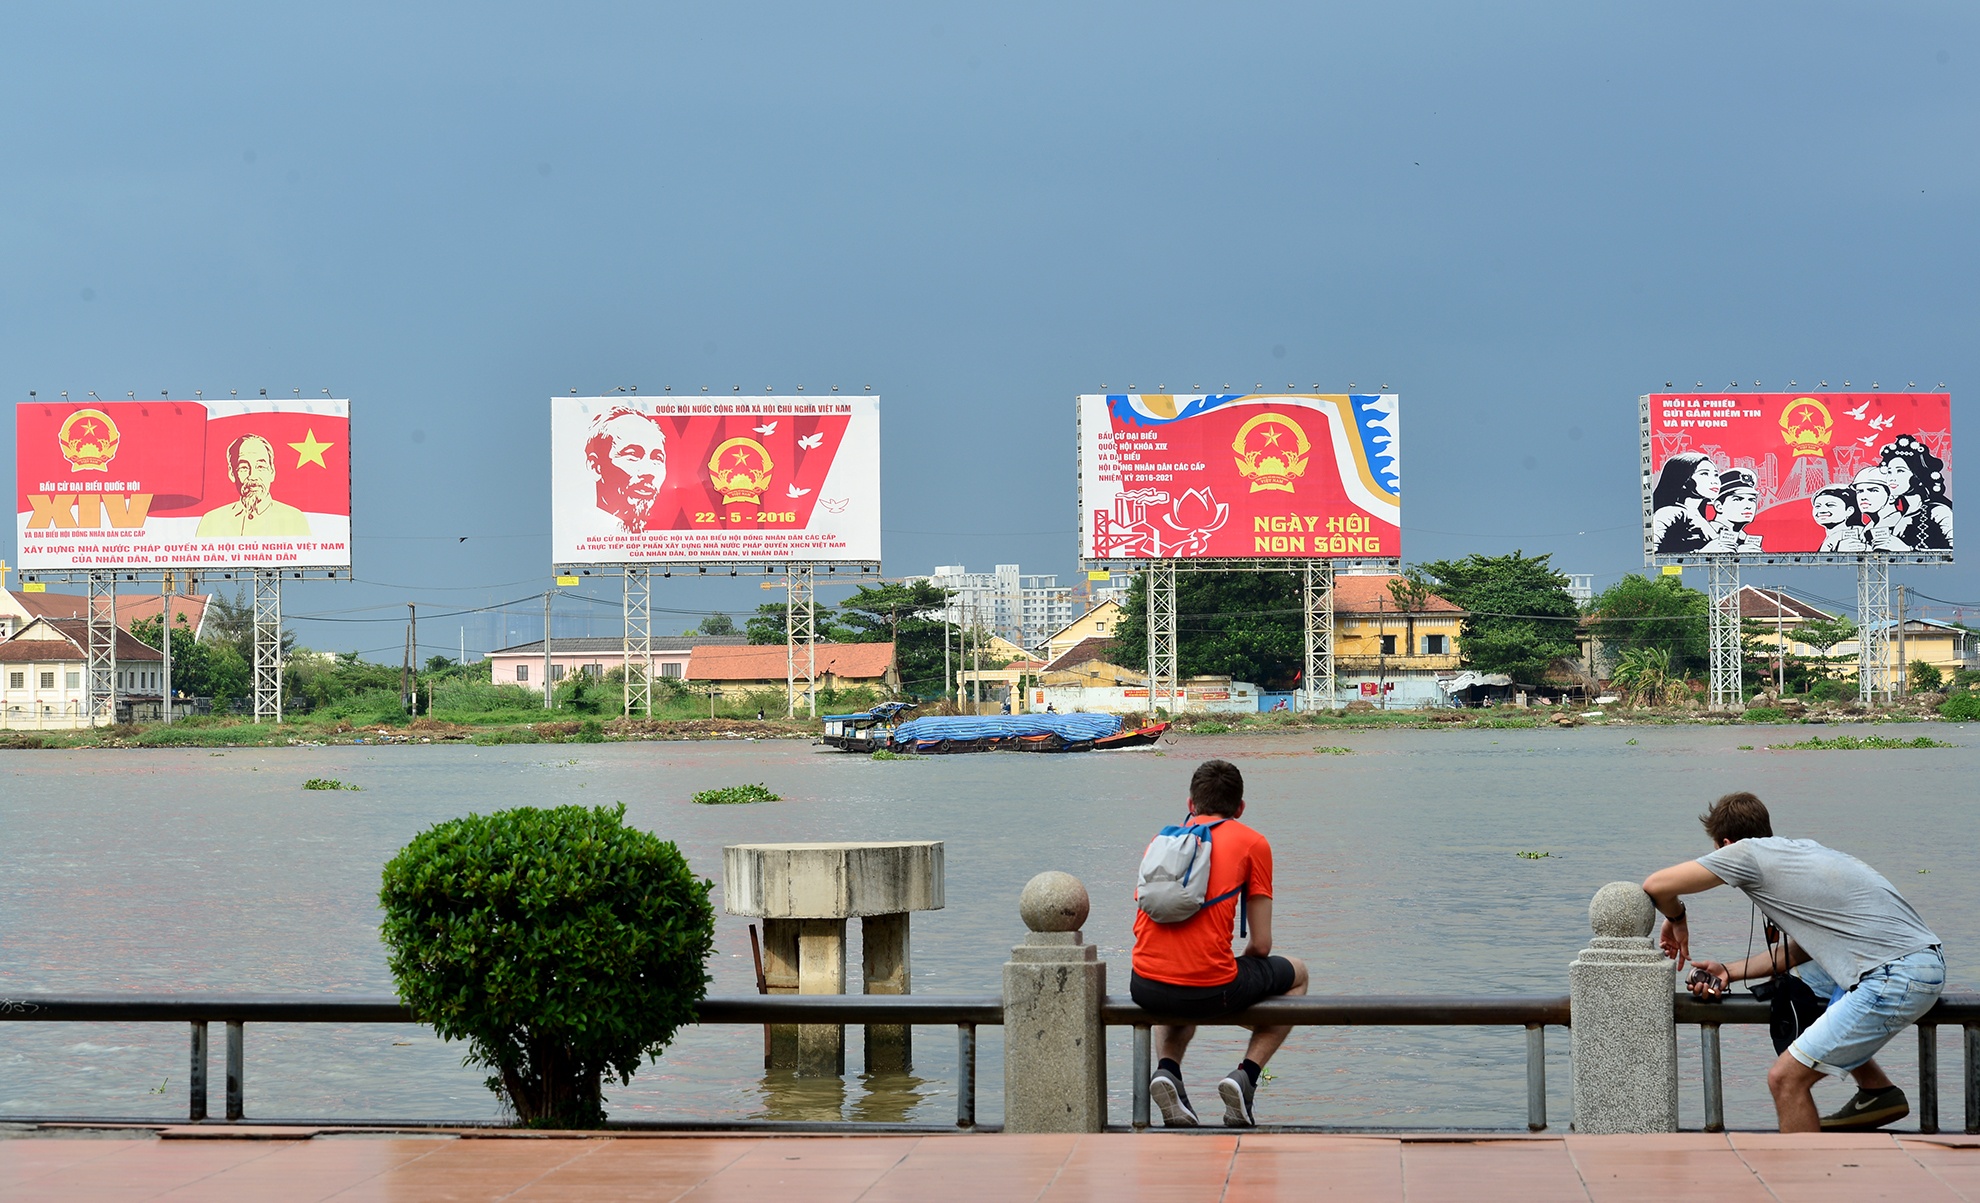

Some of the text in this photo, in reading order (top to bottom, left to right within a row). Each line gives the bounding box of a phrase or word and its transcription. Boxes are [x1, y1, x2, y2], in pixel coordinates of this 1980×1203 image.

[835, 404, 851, 413] NAM
[1135, 474, 1173, 482] 2016-2021
[26, 494, 154, 529] XIV
[695, 512, 715, 523] 22
[731, 512, 742, 523] 5
[757, 511, 796, 523] 2016
[1254, 512, 1370, 535] NGÀY HỘI
[1254, 533, 1380, 553] NON SÔNG
[72, 553, 92, 563] CỦA
[96, 555, 124, 563] NHÂN
[172, 554, 200, 562] NHÂN
[231, 553, 241, 561] VÌ
[244, 552, 272, 561] NHÂN
[276, 553, 297, 561] DÂN
